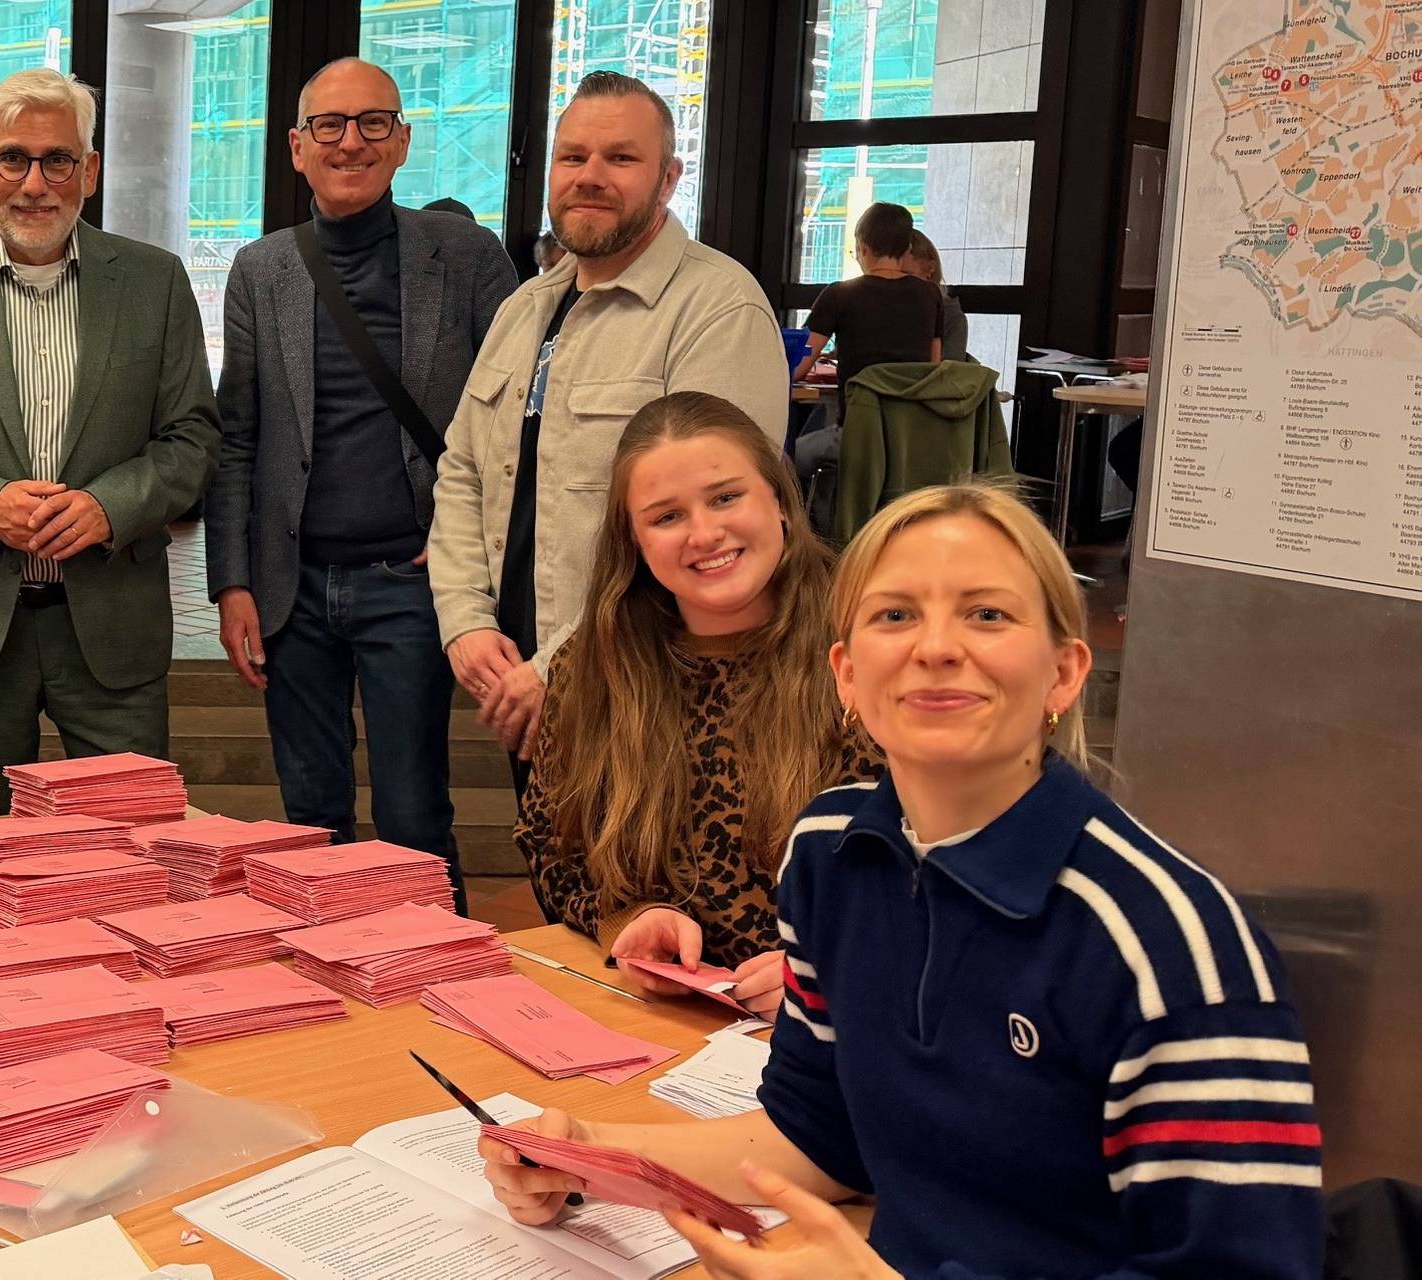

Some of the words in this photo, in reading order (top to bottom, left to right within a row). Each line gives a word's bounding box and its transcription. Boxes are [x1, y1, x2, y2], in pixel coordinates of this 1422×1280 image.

[1290, 51, 1343, 64] Wattenscheid
[1230, 71, 1253, 80] Leithe
[1282, 127, 1297, 135] feld
[1225, 135, 1253, 143] Seving-
[1234, 148, 1262, 156] hausen
[1318, 171, 1361, 182] Eppendorf
[1307, 226, 1351, 235] Munscheid
[1243, 238, 1288, 247] Dahlhausen
[1324, 284, 1352, 293] Linden
